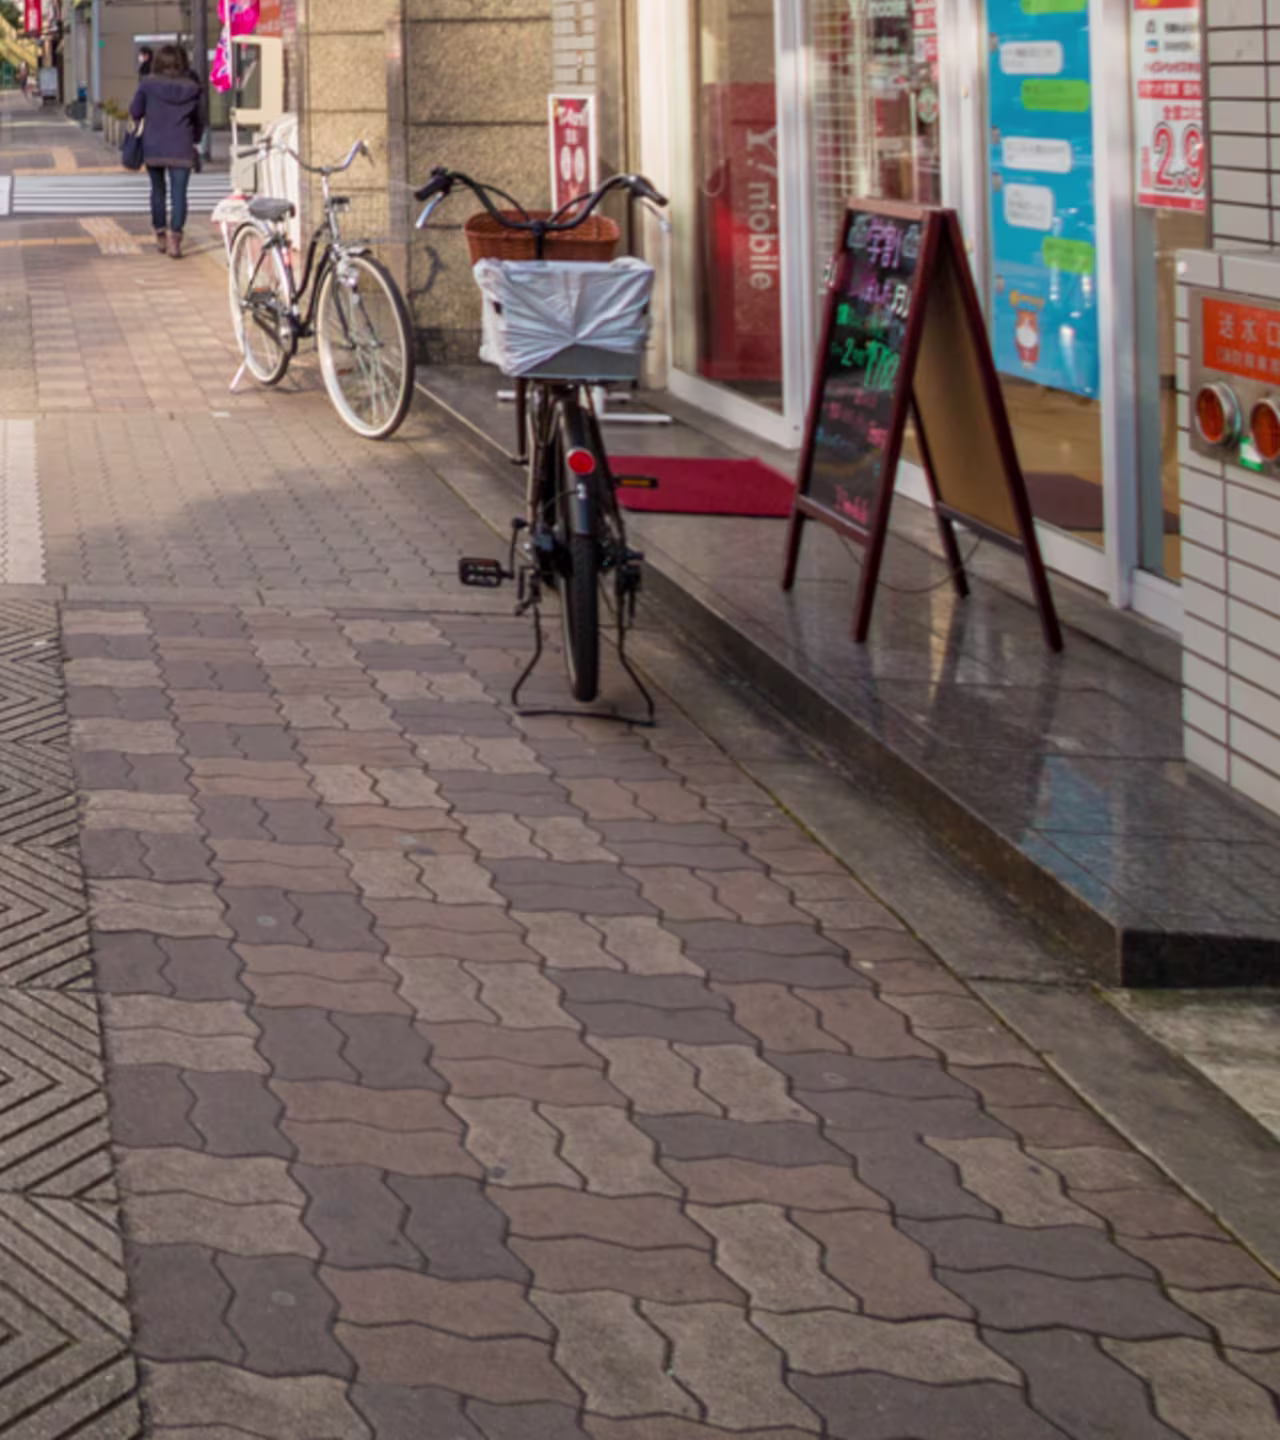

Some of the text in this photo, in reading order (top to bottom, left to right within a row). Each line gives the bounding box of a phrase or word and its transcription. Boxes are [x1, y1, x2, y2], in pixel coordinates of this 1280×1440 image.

[745, 127, 779, 291] Y!mobile
[1218, 311, 1280, 348] 送水口
